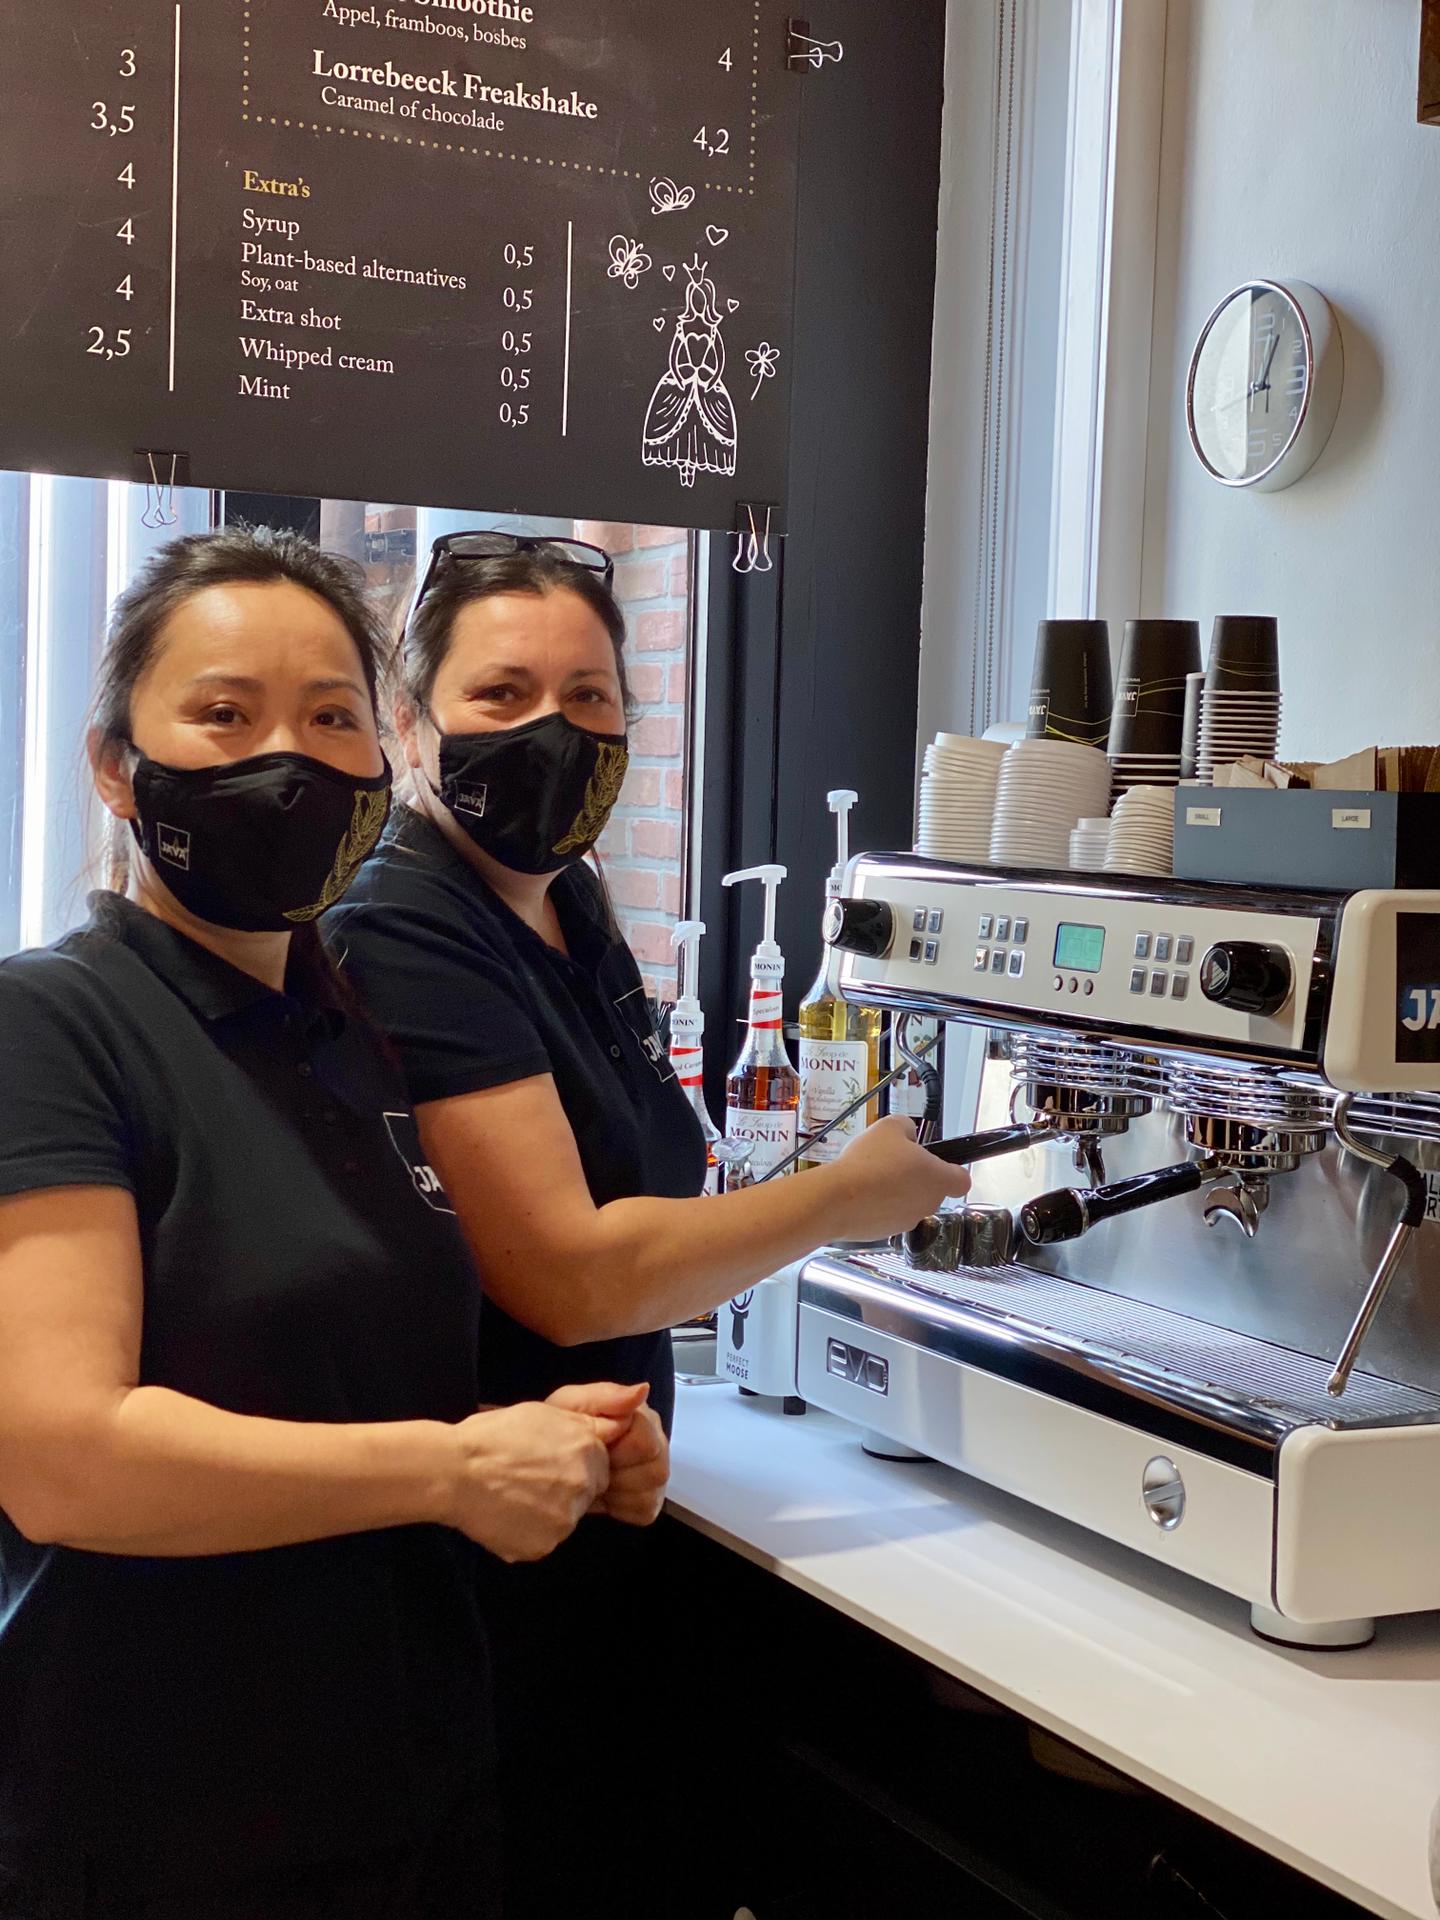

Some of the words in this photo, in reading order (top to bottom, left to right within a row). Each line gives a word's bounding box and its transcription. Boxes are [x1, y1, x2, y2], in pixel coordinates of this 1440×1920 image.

[323, 0, 380, 28] Appel,
[385, 9, 469, 42] framboos,
[473, 23, 526, 49] bosbes
[415, 0, 534, 23] moothie
[119, 49, 136, 77] 3
[717, 47, 733, 72] 4
[312, 49, 458, 97] Lorrebeeck
[463, 74, 598, 119] Freakshake
[90, 101, 136, 137] 3,5
[322, 86, 394, 114] Caramel
[400, 100, 421, 118] of
[422, 103, 505, 131] chocolade
[692, 125, 730, 158] 4,2
[117, 162, 136, 190] 4
[243, 169, 311, 198] Extra's
[116, 217, 136, 246] 4
[242, 207, 300, 241] Syrup
[240, 242, 357, 276] Plant-based
[363, 259, 467, 290] alternatives
[503, 243, 534, 270] 0,5
[115, 273, 134, 301] 4
[240, 269, 272, 292] Soy,
[274, 279, 299, 292] oat
[502, 286, 534, 313] 0,5
[240, 299, 295, 326] Extra
[300, 308, 342, 331] shot
[86, 326, 132, 361] 2,5
[238, 337, 333, 371] Whipped
[338, 356, 395, 374] cream
[501, 330, 533, 357] 0,5
[237, 374, 291, 400] Mint
[500, 366, 532, 392] 0,5
[499, 402, 530, 428] 0,5
[754, 963, 781, 971] MONIN
[801, 1056, 857, 1073] MONIN
[730, 1126, 789, 1143] MONIN
[726, 1361, 749, 1381] MOOSE
